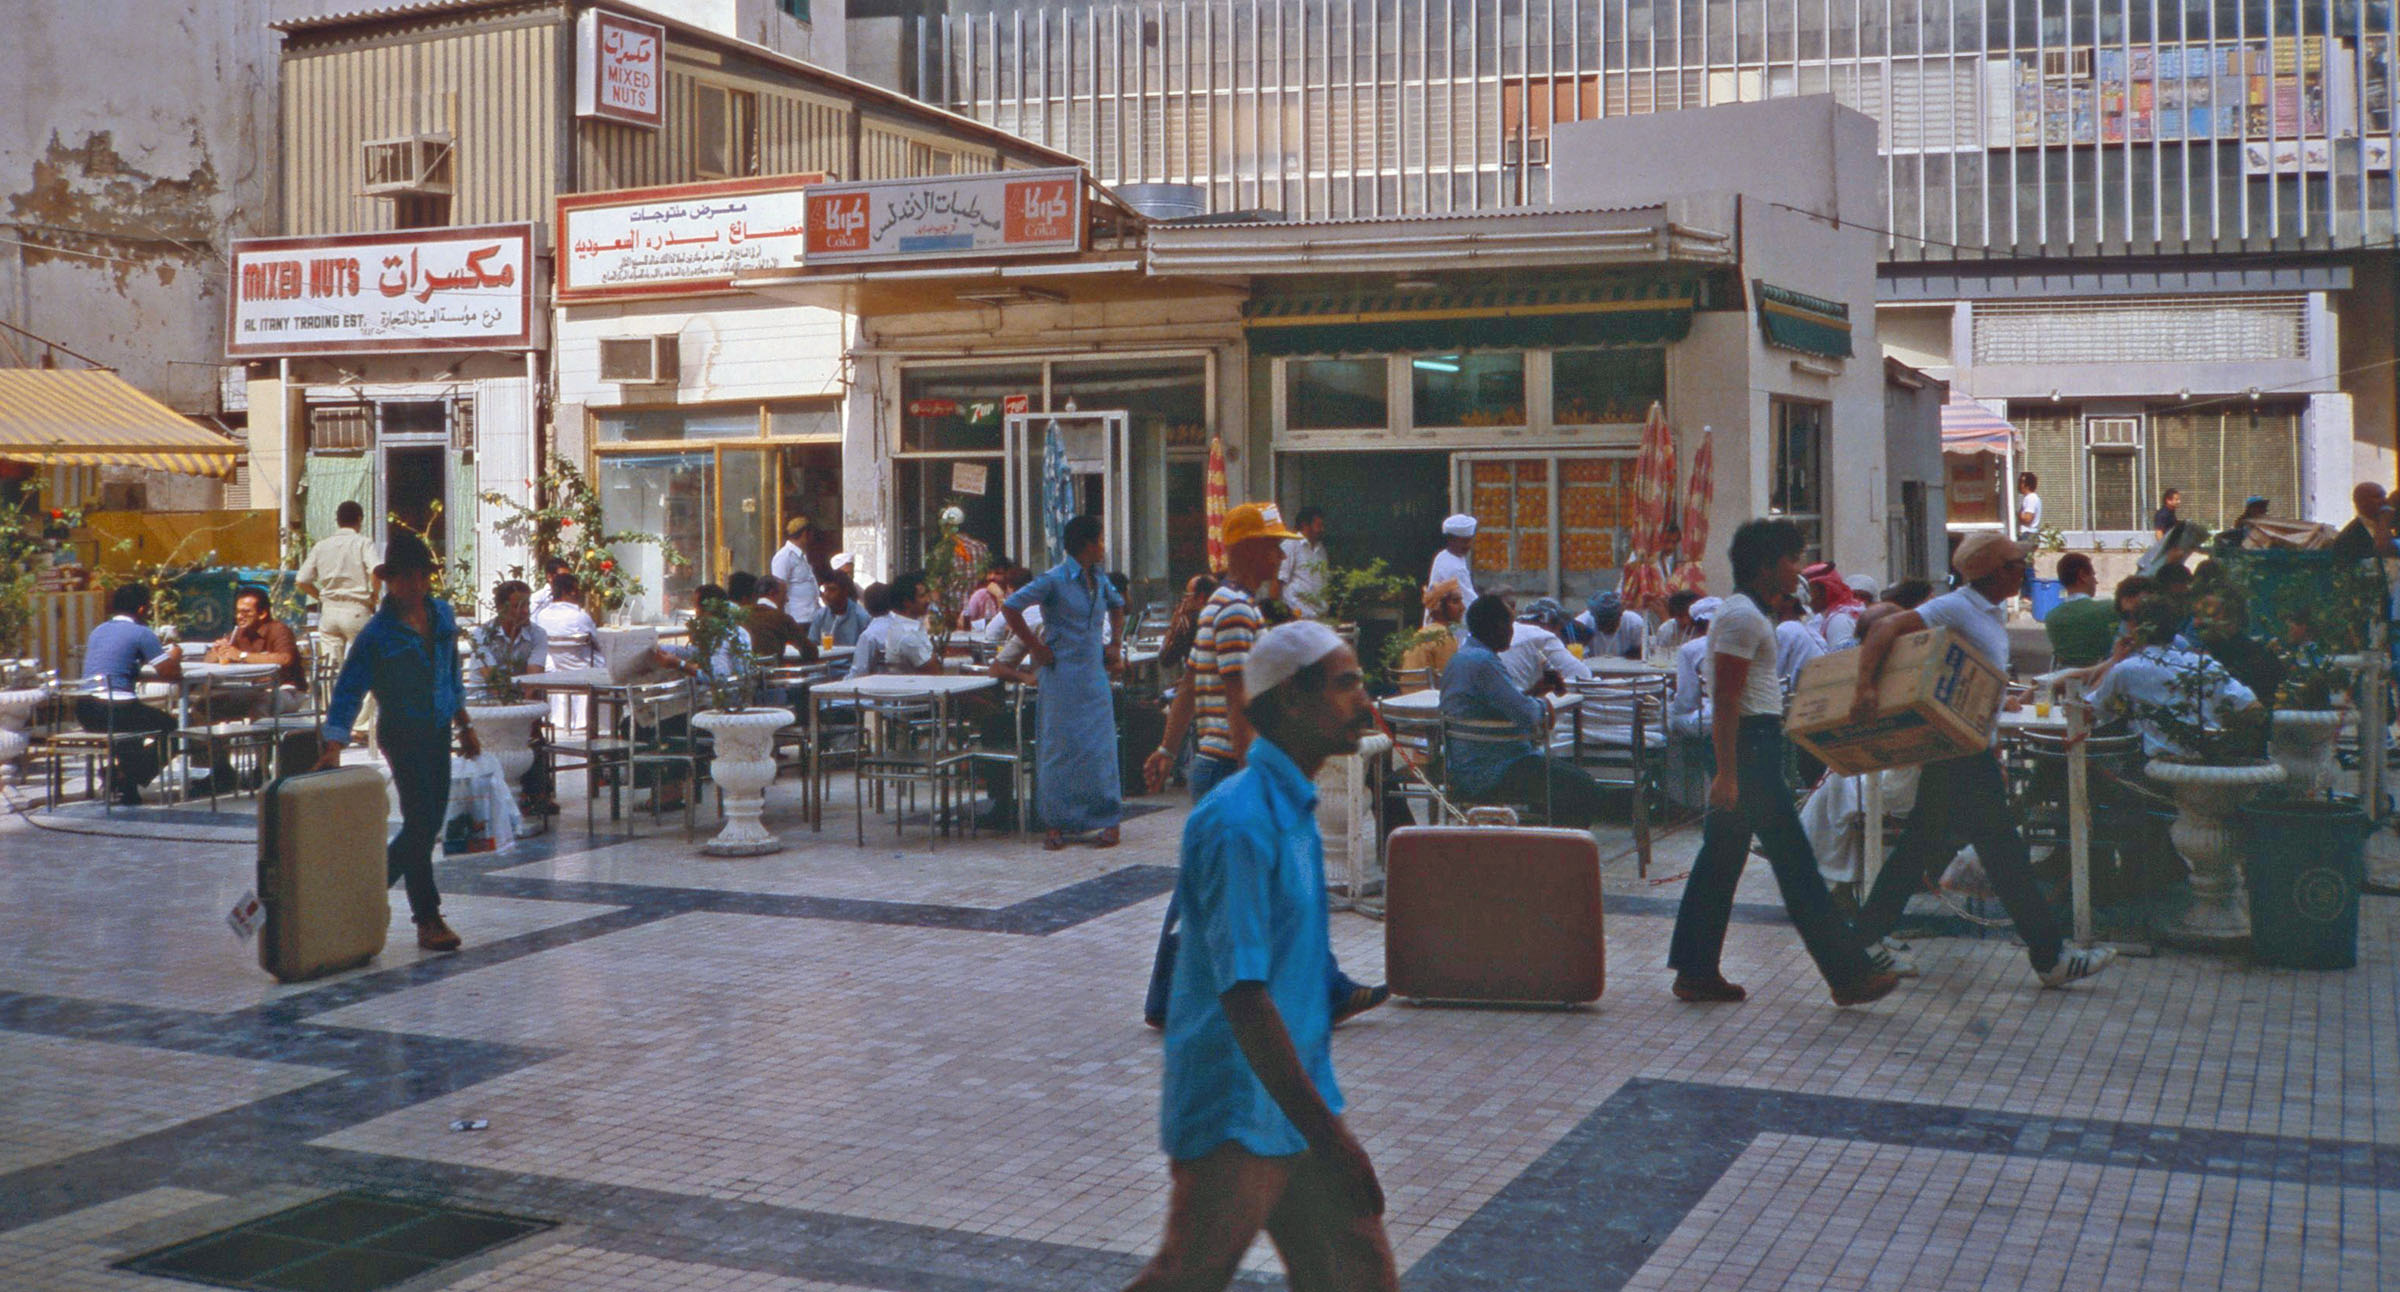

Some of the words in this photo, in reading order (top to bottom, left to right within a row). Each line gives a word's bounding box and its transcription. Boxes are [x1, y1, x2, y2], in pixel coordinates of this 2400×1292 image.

[604, 32, 651, 65] مكسرات
[607, 64, 650, 89] MIXED
[613, 85, 647, 107] NUTS
[629, 205, 687, 224] منتوجات
[690, 203, 748, 220] معرض
[729, 220, 804, 245] مصانع
[243, 261, 302, 301] MIXED
[309, 257, 360, 298] NUTS
[379, 245, 515, 304] مكسرات
[244, 318, 257, 332] AL
[260, 317, 290, 331] ITANY
[293, 315, 340, 330] TRADING
[343, 314, 367, 328] EST.
[482, 307, 502, 328] فرع
